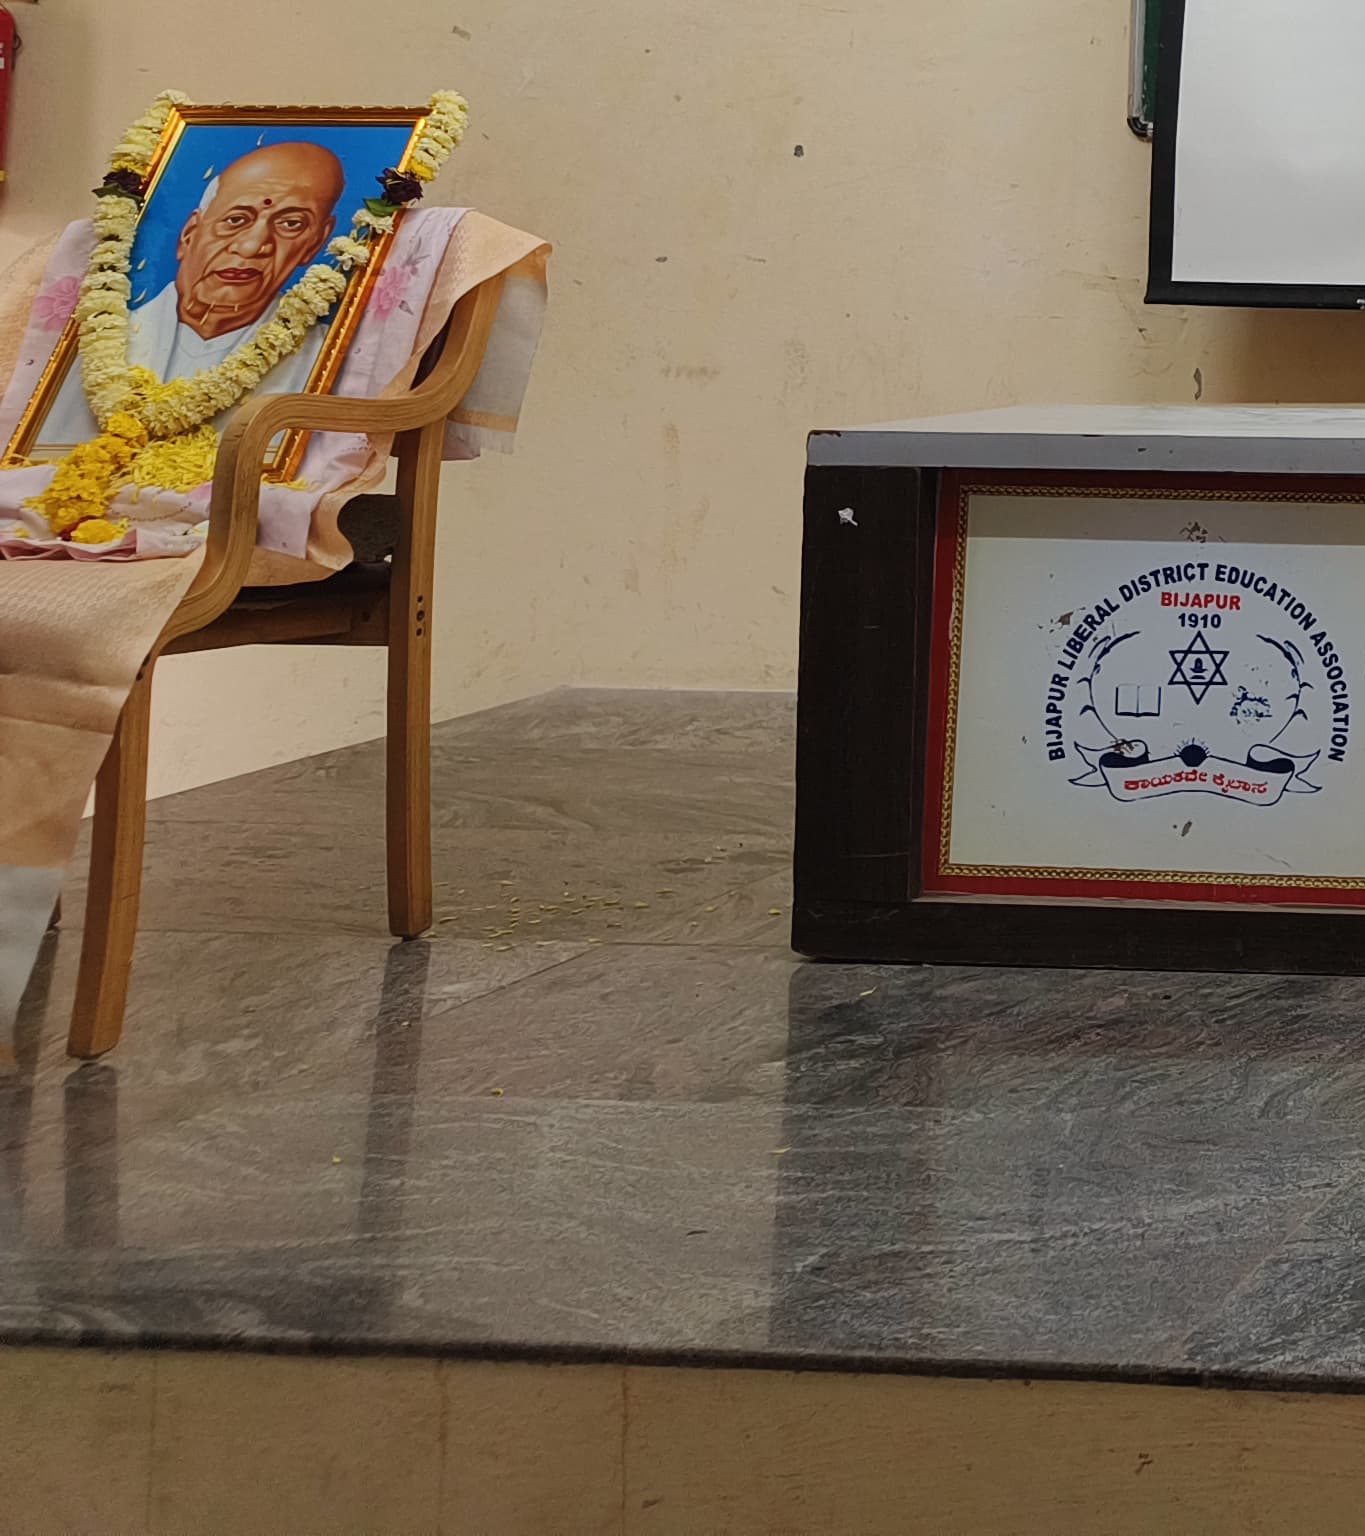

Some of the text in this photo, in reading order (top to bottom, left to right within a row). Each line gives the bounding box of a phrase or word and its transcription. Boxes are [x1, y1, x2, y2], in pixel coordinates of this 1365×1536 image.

[1160, 591, 1242, 610] BIJAPUR
[1178, 613, 1222, 629] 1910
[1045, 562, 1349, 763] BIJAPUR LIBERAL DISTRICT EDUCATION ASSOCIATION
